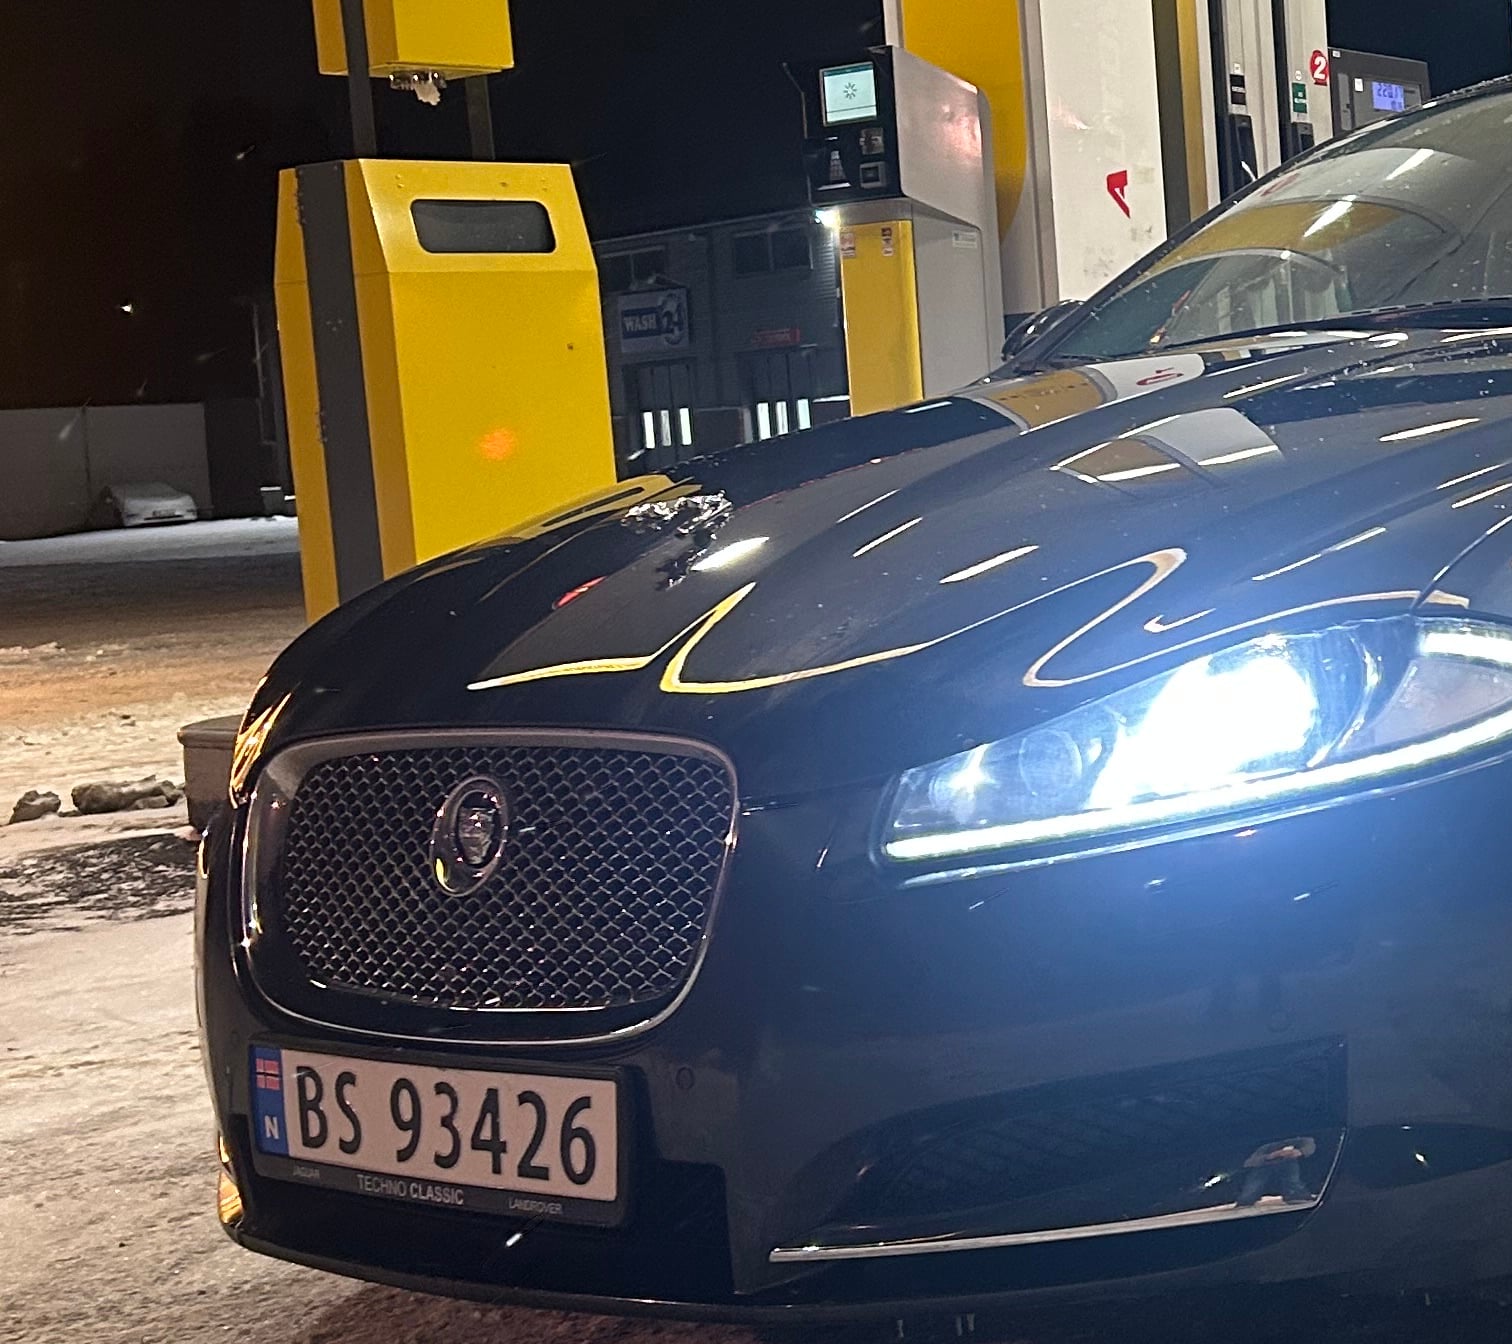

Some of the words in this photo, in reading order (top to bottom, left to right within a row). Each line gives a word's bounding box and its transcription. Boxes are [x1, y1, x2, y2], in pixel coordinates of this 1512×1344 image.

[623, 313, 657, 332] WASH
[263, 1115, 280, 1140] N
[296, 1065, 362, 1155] BS
[389, 1077, 597, 1186] 93426
[356, 1173, 406, 1197] TECHNO
[409, 1182, 465, 1206] CLASSIC
